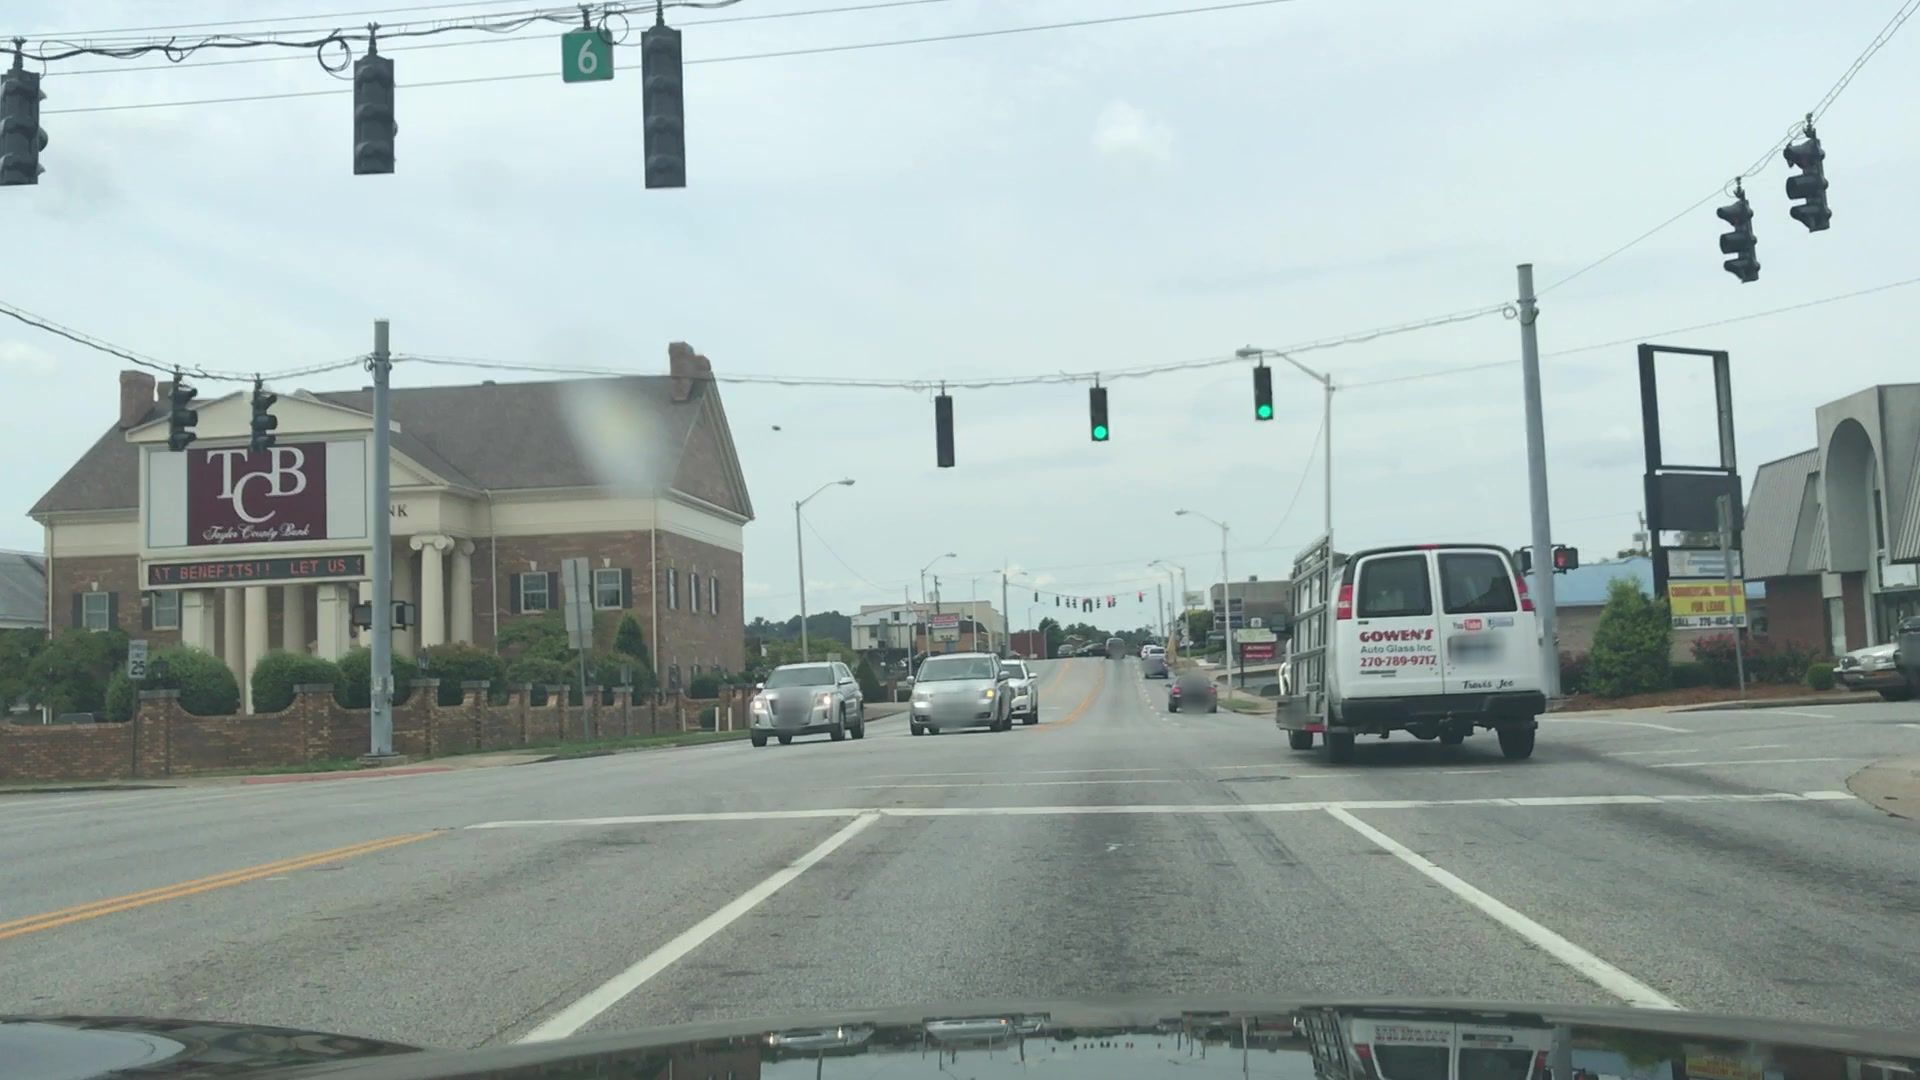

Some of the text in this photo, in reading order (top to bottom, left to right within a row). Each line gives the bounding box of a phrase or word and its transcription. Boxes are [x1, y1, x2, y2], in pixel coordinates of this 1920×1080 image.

[578, 38, 598, 74] 6
[206, 446, 307, 524] TCB
[202, 523, 311, 544] Taylor County Bank
[180, 563, 271, 580] BENEFITS!!
[290, 560, 318, 576] LET
[328, 558, 347, 573] US
[1359, 628, 1434, 643] GOWEN'S
[1360, 646, 1384, 655] Auto
[1386, 644, 1415, 653] Glass
[130, 660, 145, 676] 25
[1360, 655, 1437, 668] 270-789-9717
